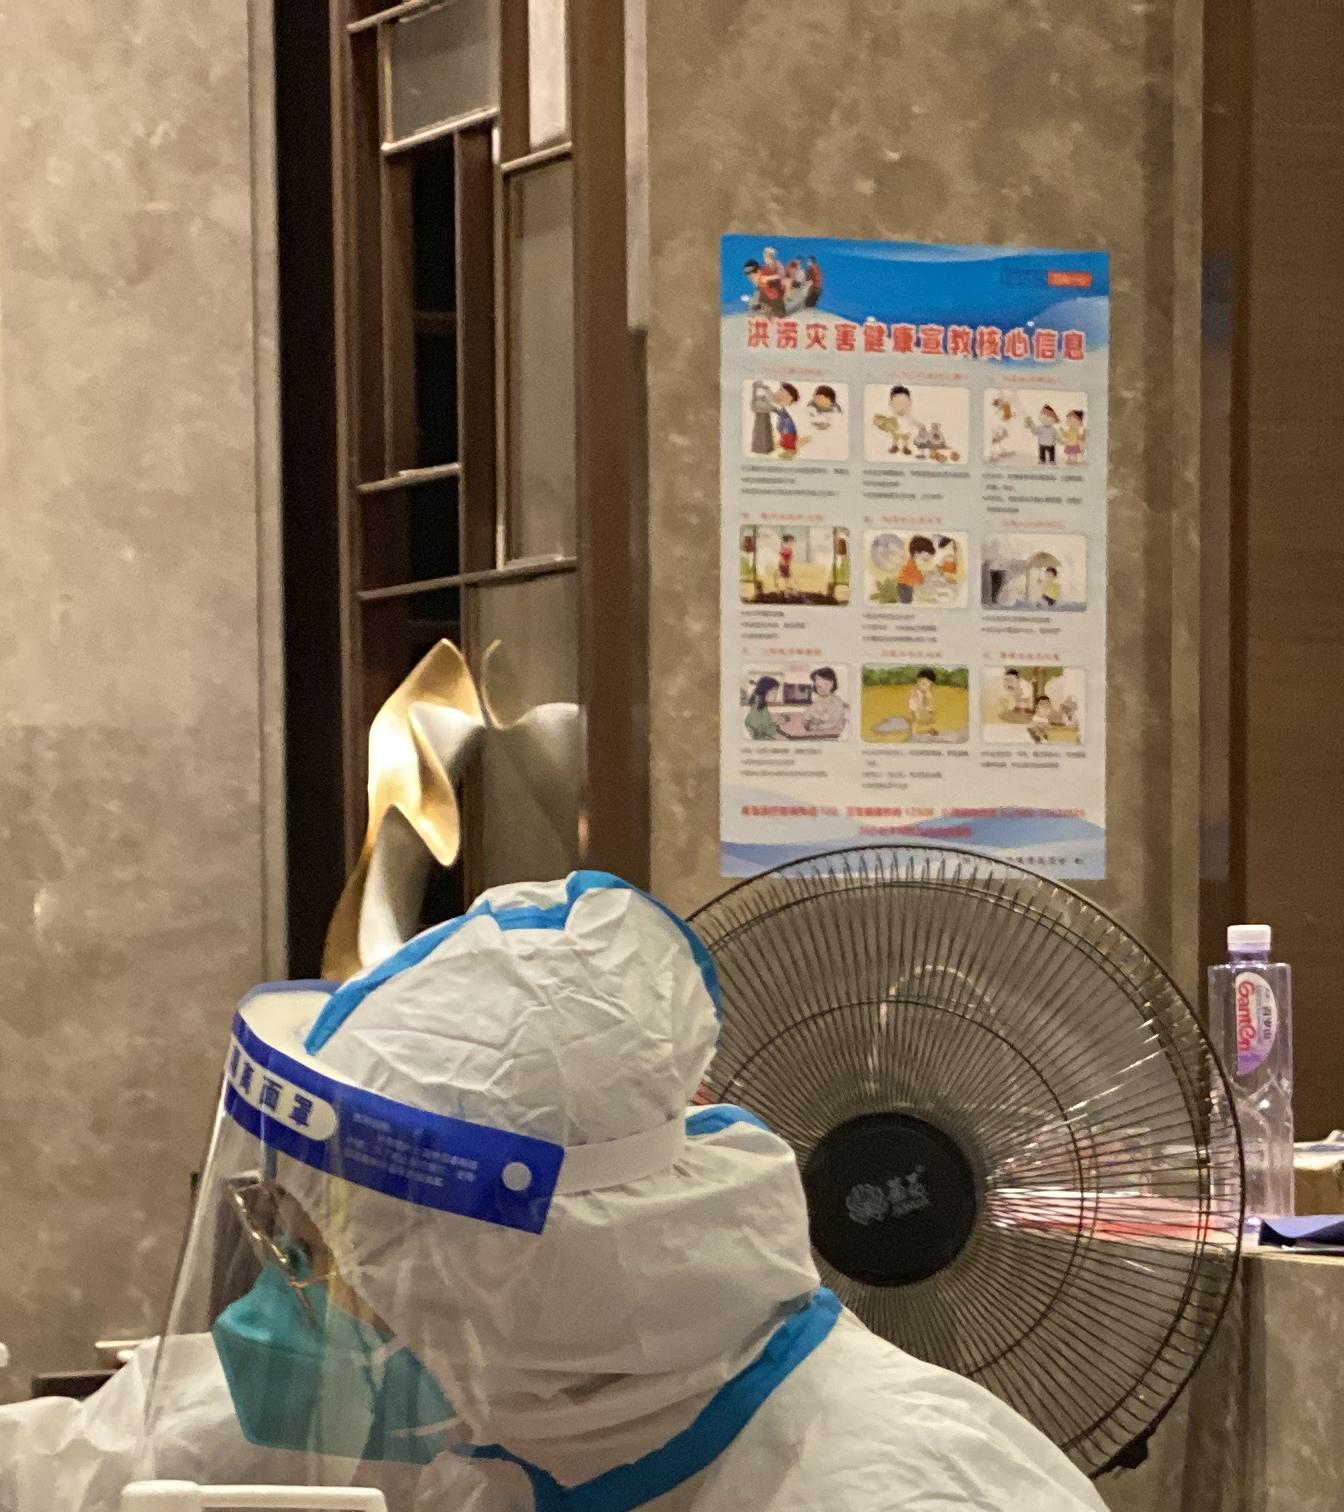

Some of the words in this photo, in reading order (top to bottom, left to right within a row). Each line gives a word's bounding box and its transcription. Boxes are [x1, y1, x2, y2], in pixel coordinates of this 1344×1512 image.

[747, 318, 1086, 361] 洪涝灾害健康宣教核心信息
